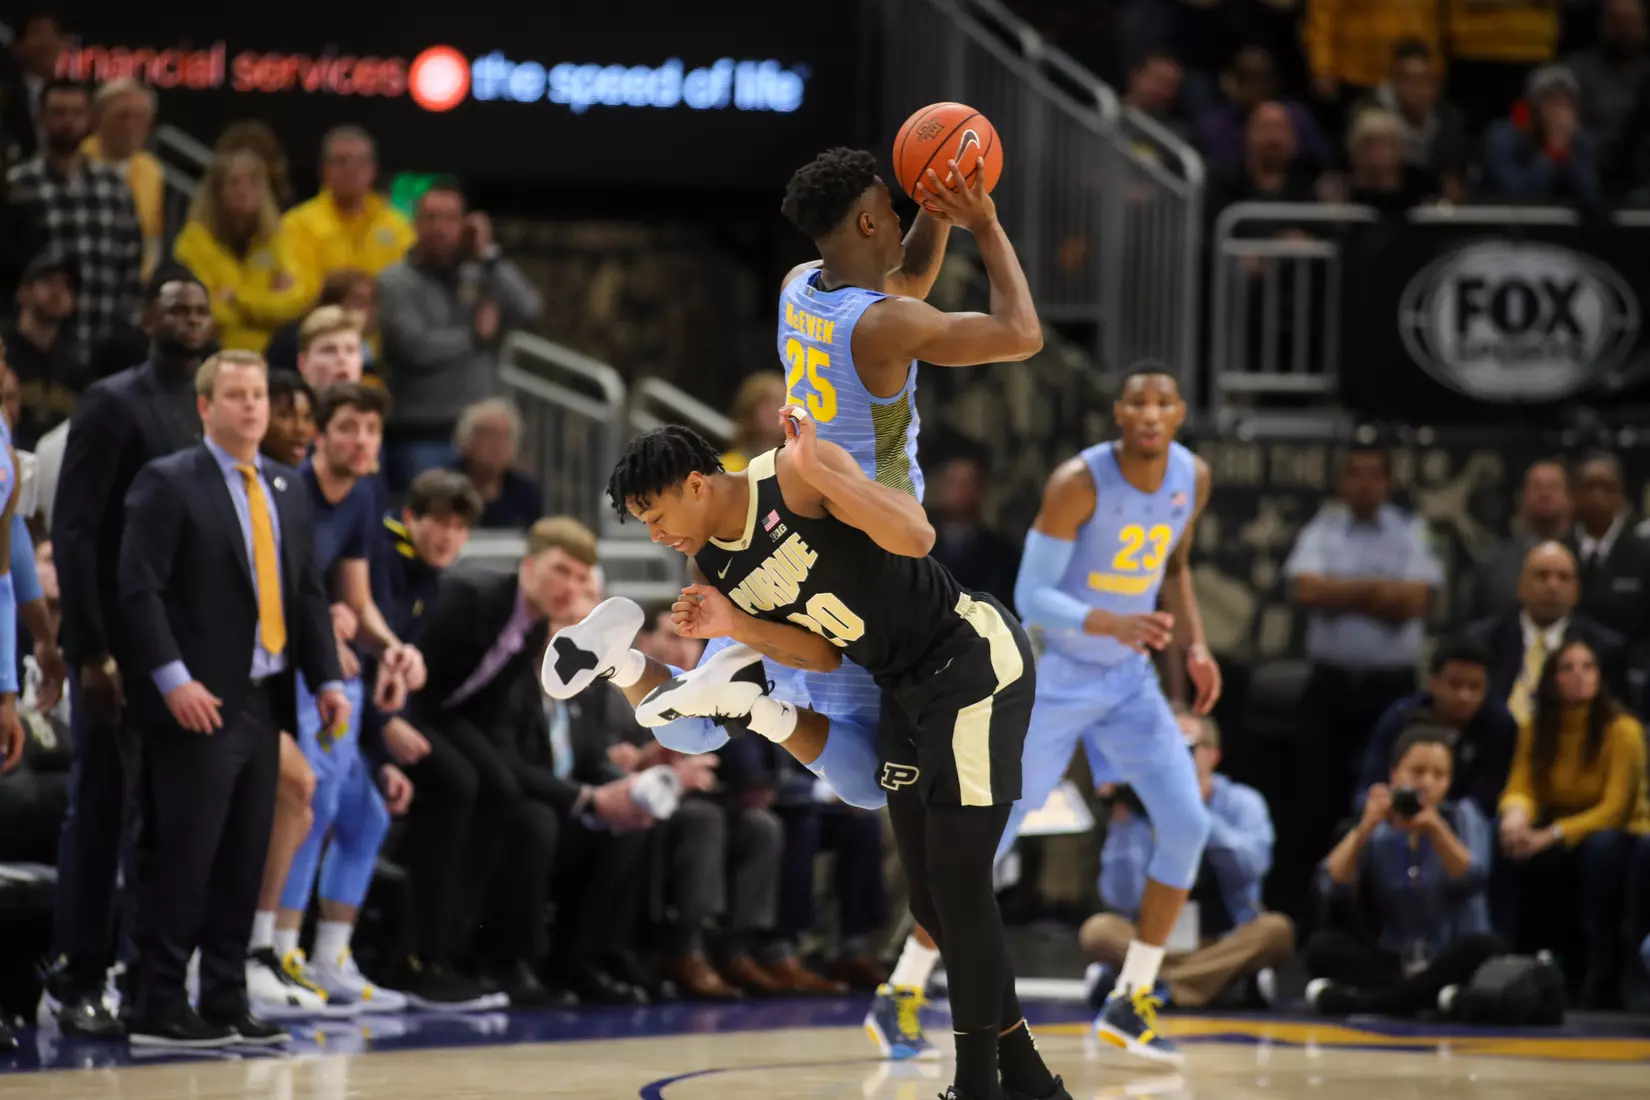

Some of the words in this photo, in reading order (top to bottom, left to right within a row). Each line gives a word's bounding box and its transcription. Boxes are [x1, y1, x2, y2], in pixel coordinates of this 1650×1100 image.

[231, 48, 408, 96] services
[471, 51, 546, 102] the
[549, 57, 683, 113] speed
[684, 58, 734, 109] of
[735, 59, 804, 112] life
[786, 301, 835, 344] McEWEN
[1456, 274, 1582, 337] FOX
[786, 337, 838, 423] 25
[728, 532, 818, 614] PURDUE
[1112, 523, 1173, 571] 23
[881, 761, 920, 791] P
